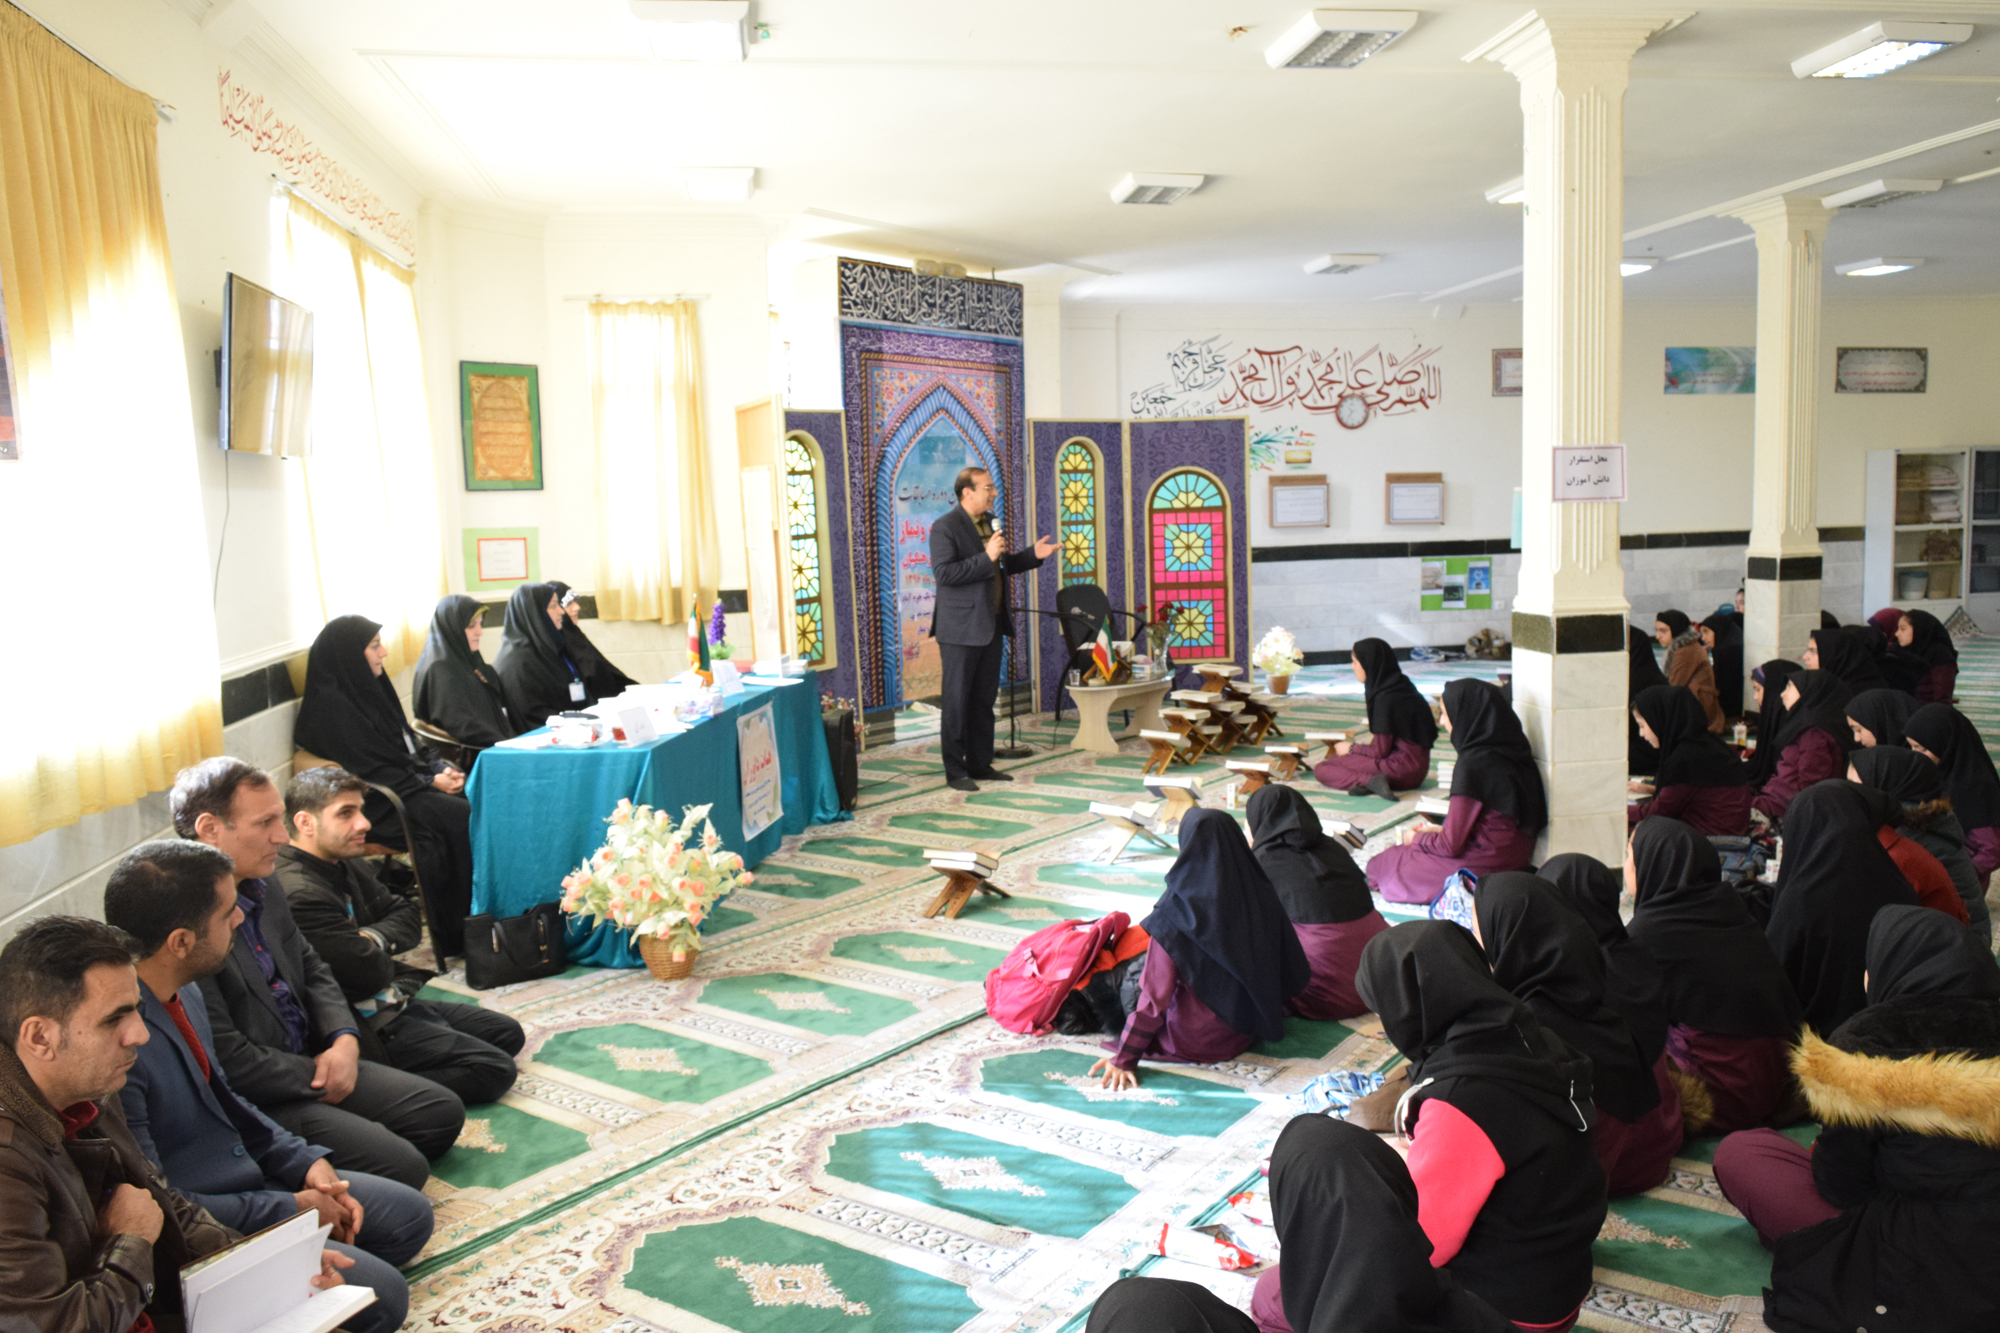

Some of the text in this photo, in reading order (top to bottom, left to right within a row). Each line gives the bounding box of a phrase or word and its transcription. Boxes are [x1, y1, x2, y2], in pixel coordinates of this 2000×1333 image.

[1217, 362, 1269, 405] محمد
[1297, 361, 1344, 401] محمد
[1594, 454, 1608, 465] محل
[1566, 474, 1610, 486] دانش آموزان
[899, 485, 931, 507] مسابقات
